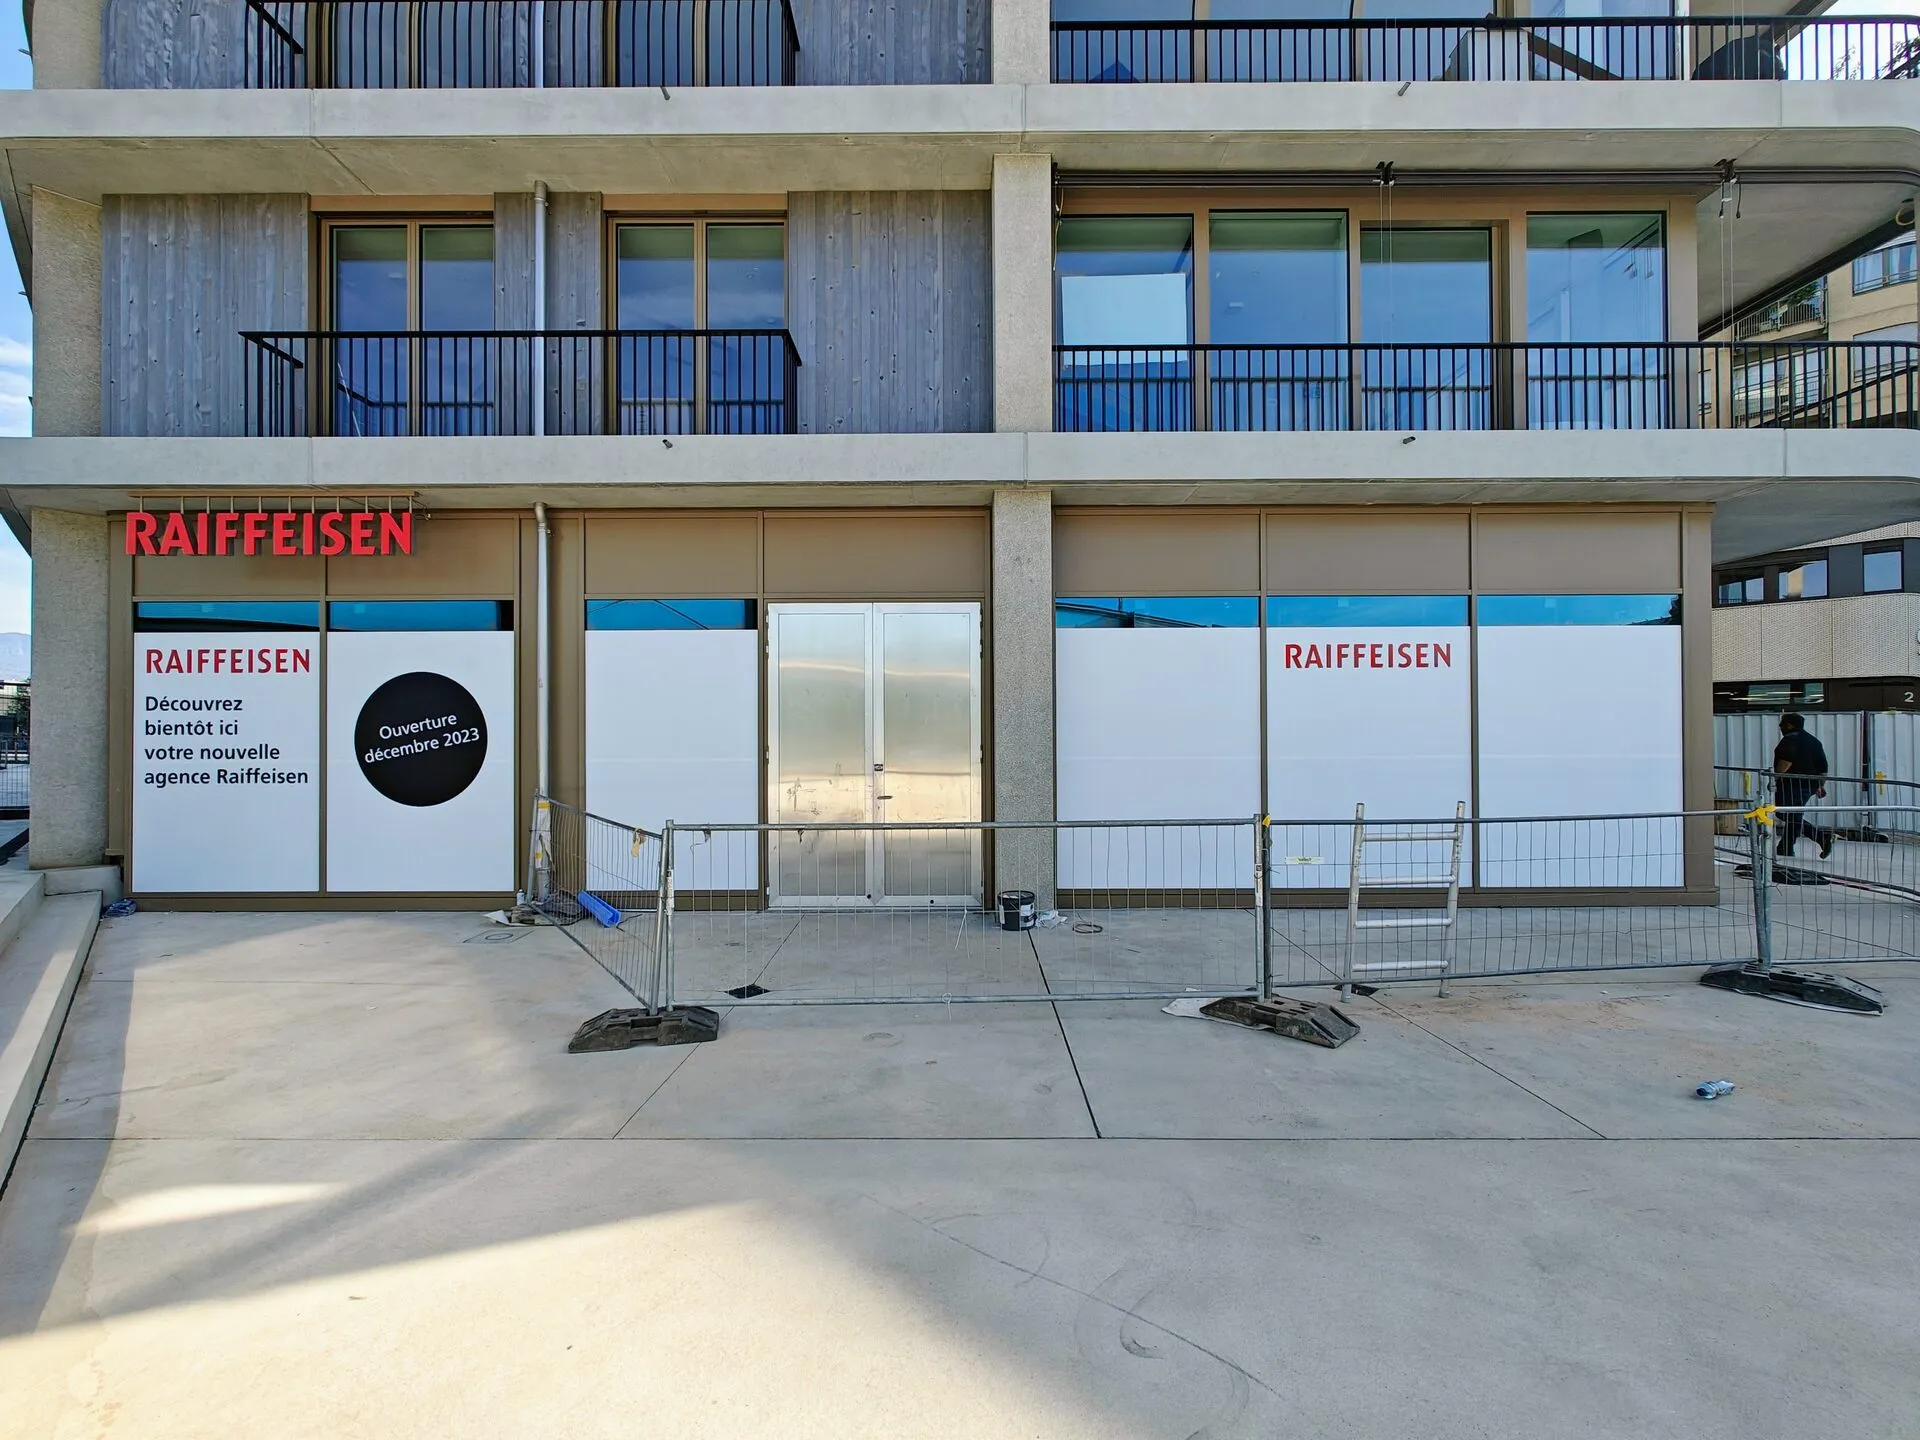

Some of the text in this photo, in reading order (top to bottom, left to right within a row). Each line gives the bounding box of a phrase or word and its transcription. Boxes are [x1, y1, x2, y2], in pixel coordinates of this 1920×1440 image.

[125, 512, 413, 556] RAIFFEISEN
[146, 648, 310, 674] RAIFFEISEN
[1284, 643, 1451, 669] RAIFFEISEN
[145, 695, 243, 712] Découvrez
[1903, 691, 1915, 703] 2
[145, 719, 239, 736] bientôt ici
[379, 714, 458, 739] Ouverture
[144, 743, 281, 760] votre nouvelle
[364, 727, 480, 763] décembre 2023
[144, 767, 309, 789] agence Raiffeisen
